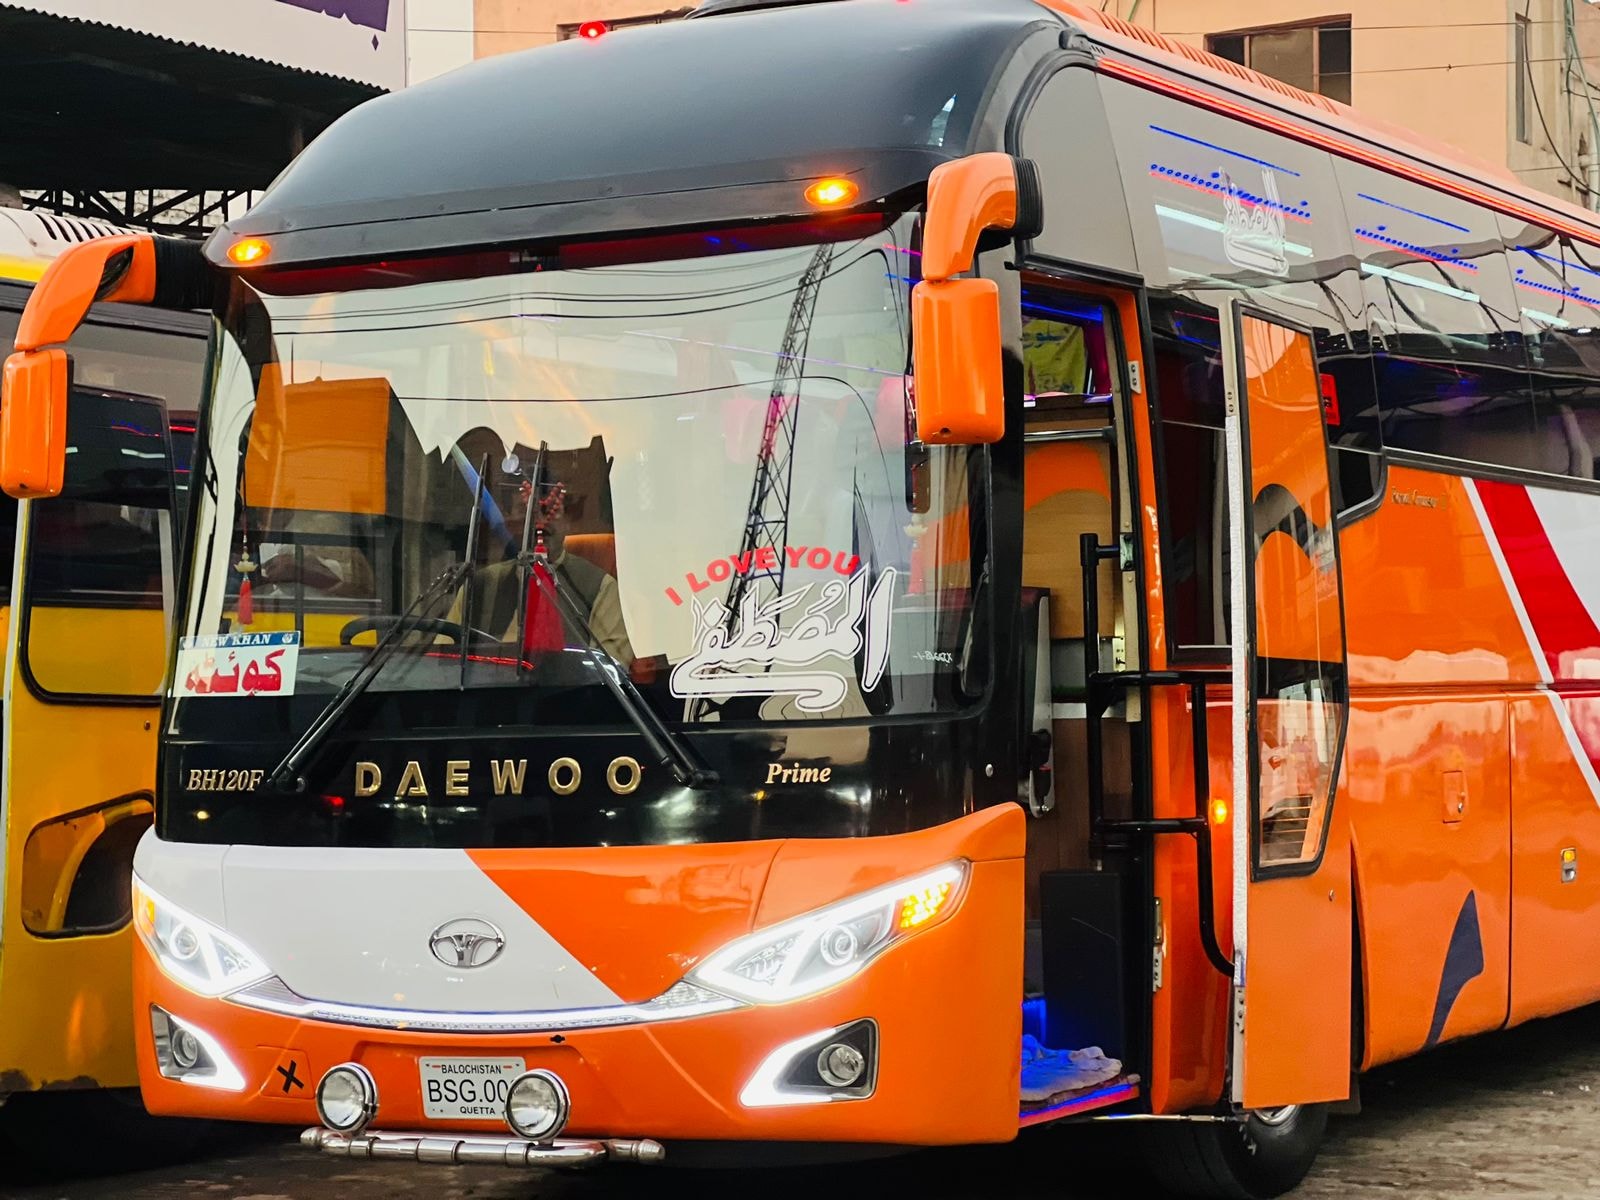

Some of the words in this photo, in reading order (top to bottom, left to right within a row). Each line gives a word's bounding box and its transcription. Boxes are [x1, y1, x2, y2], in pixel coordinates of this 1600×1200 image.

[664, 586, 683, 606] I
[685, 547, 776, 593] LOVE
[783, 546, 861, 576] YOU
[202, 635, 228, 648] NEW
[231, 633, 272, 646] KHAN
[186, 769, 264, 792] BH120F
[354, 756, 642, 797] DAEWOO
[764, 763, 832, 784] Prime
[441, 1064, 502, 1075] BALOCHISTAN
[427, 1079, 514, 1103] BSG.00
[460, 1106, 496, 1115] QUETTA
